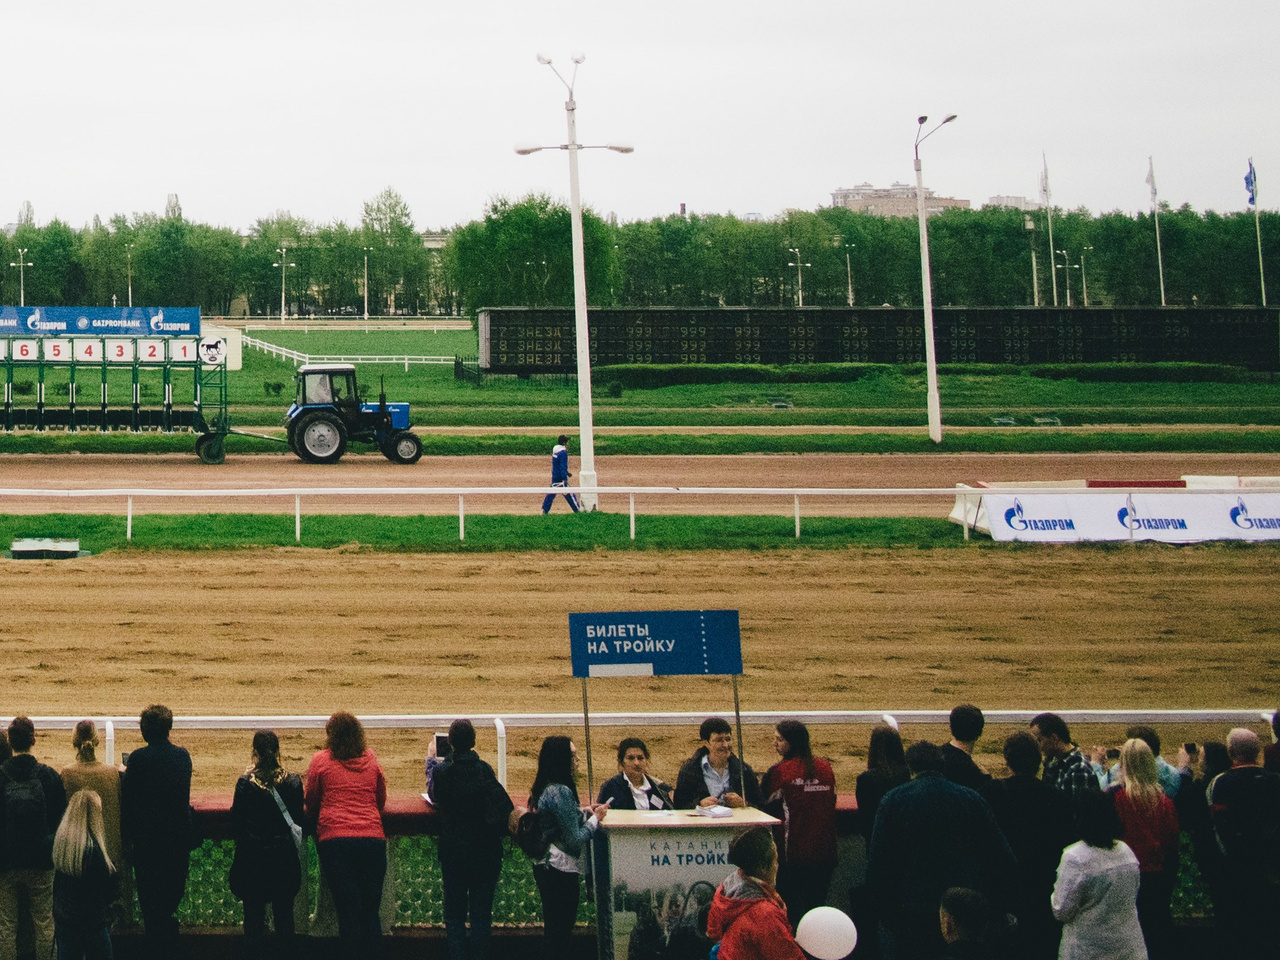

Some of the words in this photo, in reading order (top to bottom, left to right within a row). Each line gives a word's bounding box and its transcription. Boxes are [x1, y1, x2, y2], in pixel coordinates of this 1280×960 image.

[92, 319, 141, 328] GAZPROMBANK
[20, 344, 29, 357] 6
[52, 345, 61, 357] 5
[84, 345, 93, 357] 4
[116, 345, 125, 357] 3
[148, 345, 157, 357] 2
[181, 345, 187, 357] 1
[1028, 518, 1075, 530] ГАЗПРОМ
[1141, 518, 1188, 530] ГАЗПРОМ
[1253, 518, 1280, 530] ГАЗПР
[586, 624, 649, 638] БИЛЕТЫ
[587, 641, 609, 654] НА
[614, 637, 675, 653] ТРОЙКУ
[650, 841, 723, 851] КАТАНИ
[651, 854, 671, 866] НА
